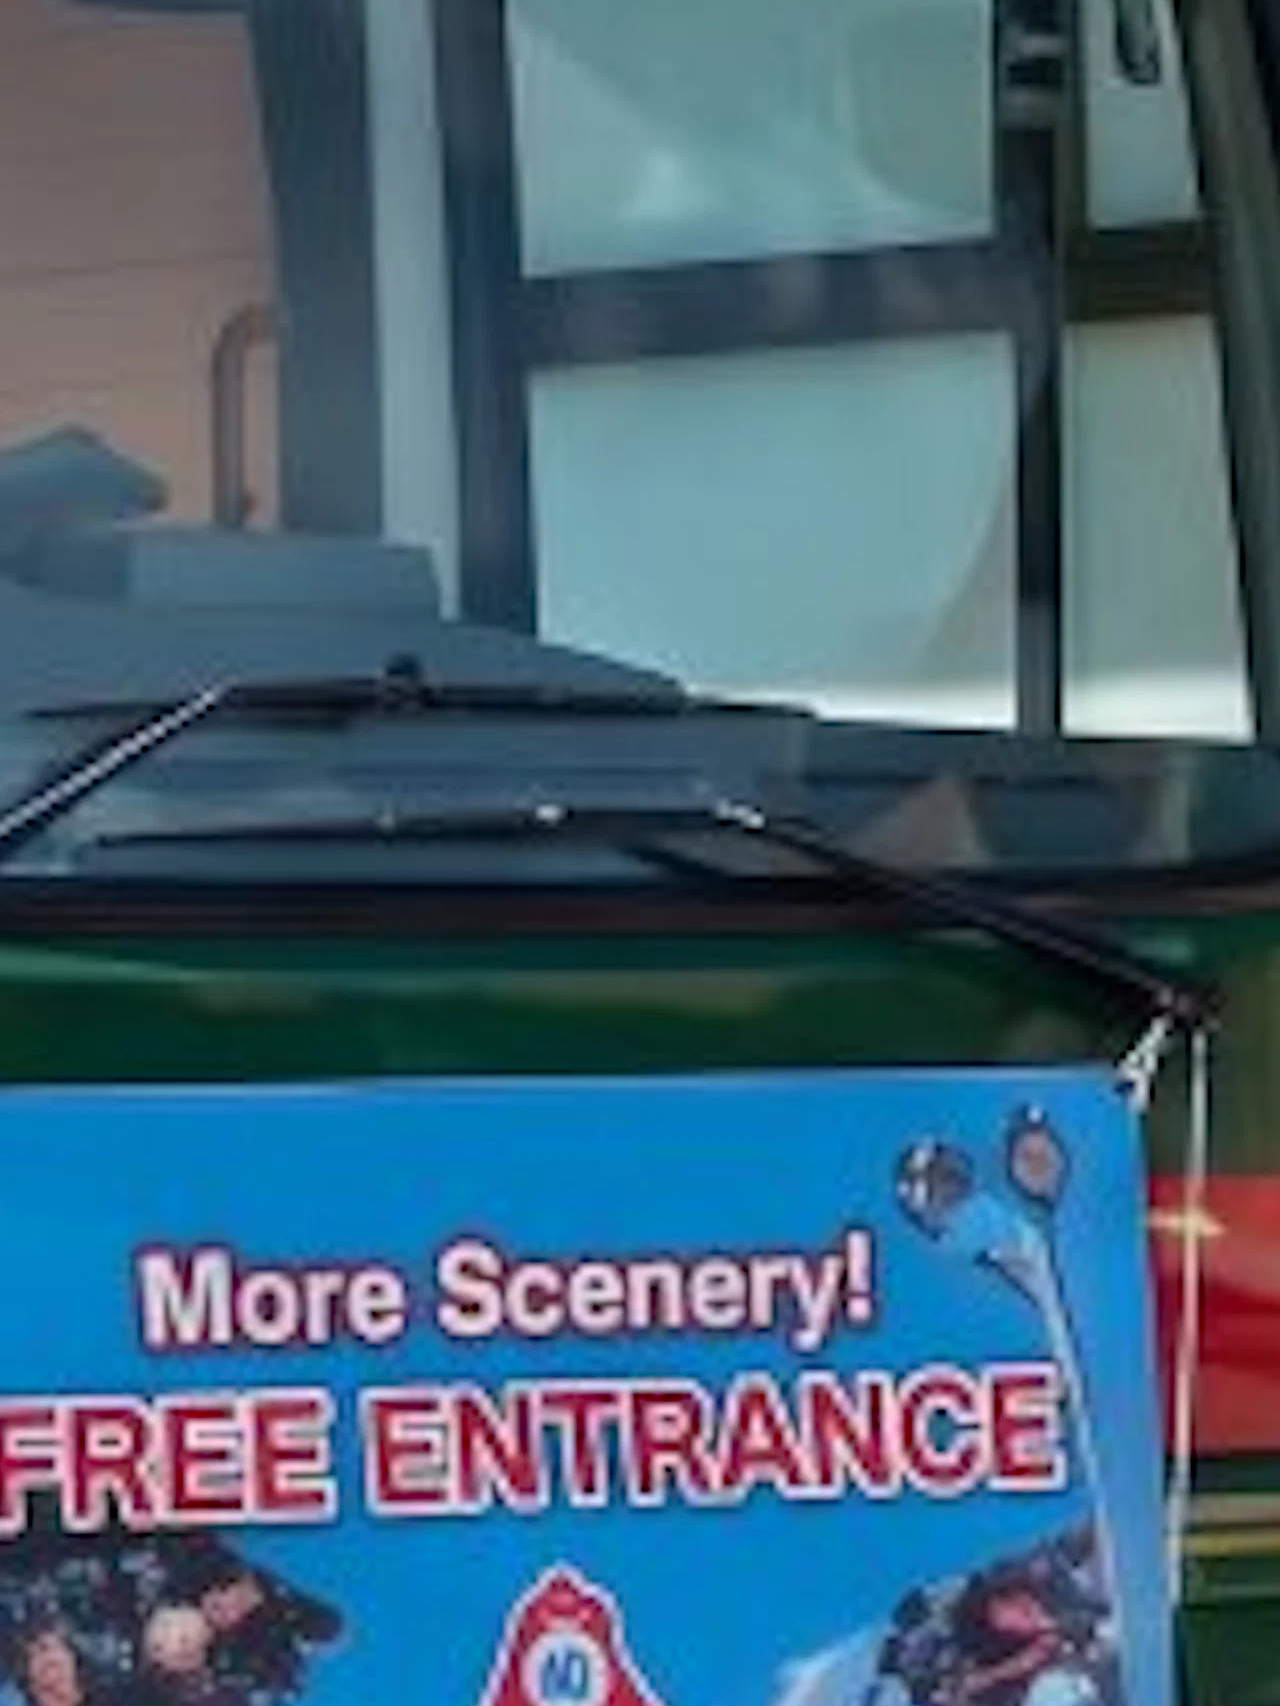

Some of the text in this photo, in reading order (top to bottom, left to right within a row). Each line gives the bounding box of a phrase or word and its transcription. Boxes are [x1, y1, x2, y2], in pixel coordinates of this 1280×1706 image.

[137, 1229, 876, 1355] More Scenery!
[367, 1365, 1067, 1516] ENTRANCE
